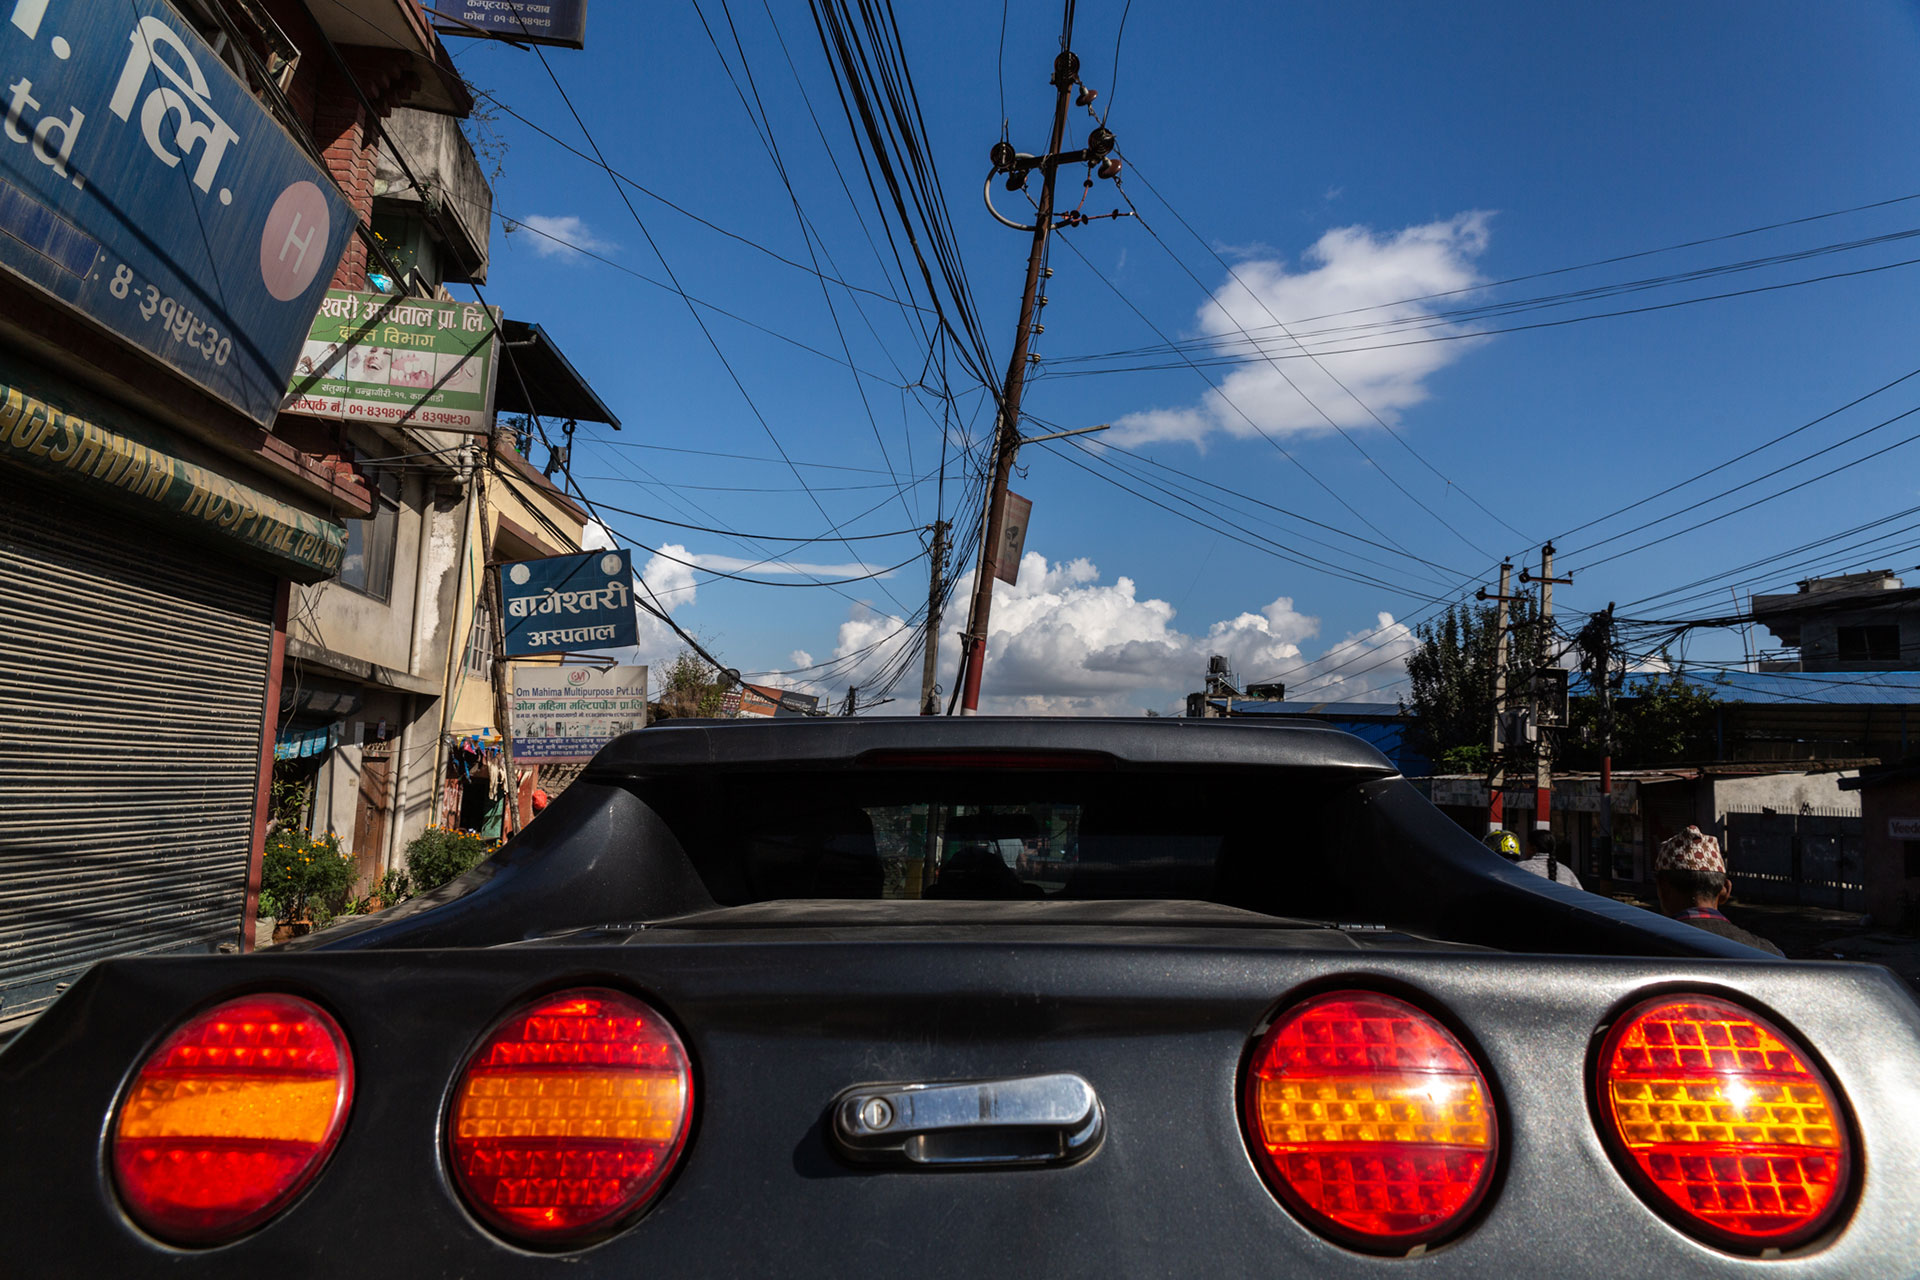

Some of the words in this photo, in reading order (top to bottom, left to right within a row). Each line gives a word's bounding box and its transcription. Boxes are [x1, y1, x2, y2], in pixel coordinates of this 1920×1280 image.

[463, 10, 485, 21] फोन
[109, 15, 240, 206] लि.
[279, 212, 316, 275] H
[363, 300, 434, 327] अस्पताल
[438, 310, 457, 330] प्रा.
[463, 306, 487, 332] लि.
[384, 327, 436, 347] विभाग
[0, 385, 174, 501] AGESHWARI
[181, 467, 296, 553] HOSPITAL
[508, 581, 629, 617] बागेश्वरी
[527, 624, 616, 646] अस्पताल
[515, 701, 536, 711] ओम
[538, 700, 566, 711] महिमा
[516, 688, 530, 697] Om
[532, 687, 562, 697] Mahima
[564, 687, 615, 698] Multipurpose
